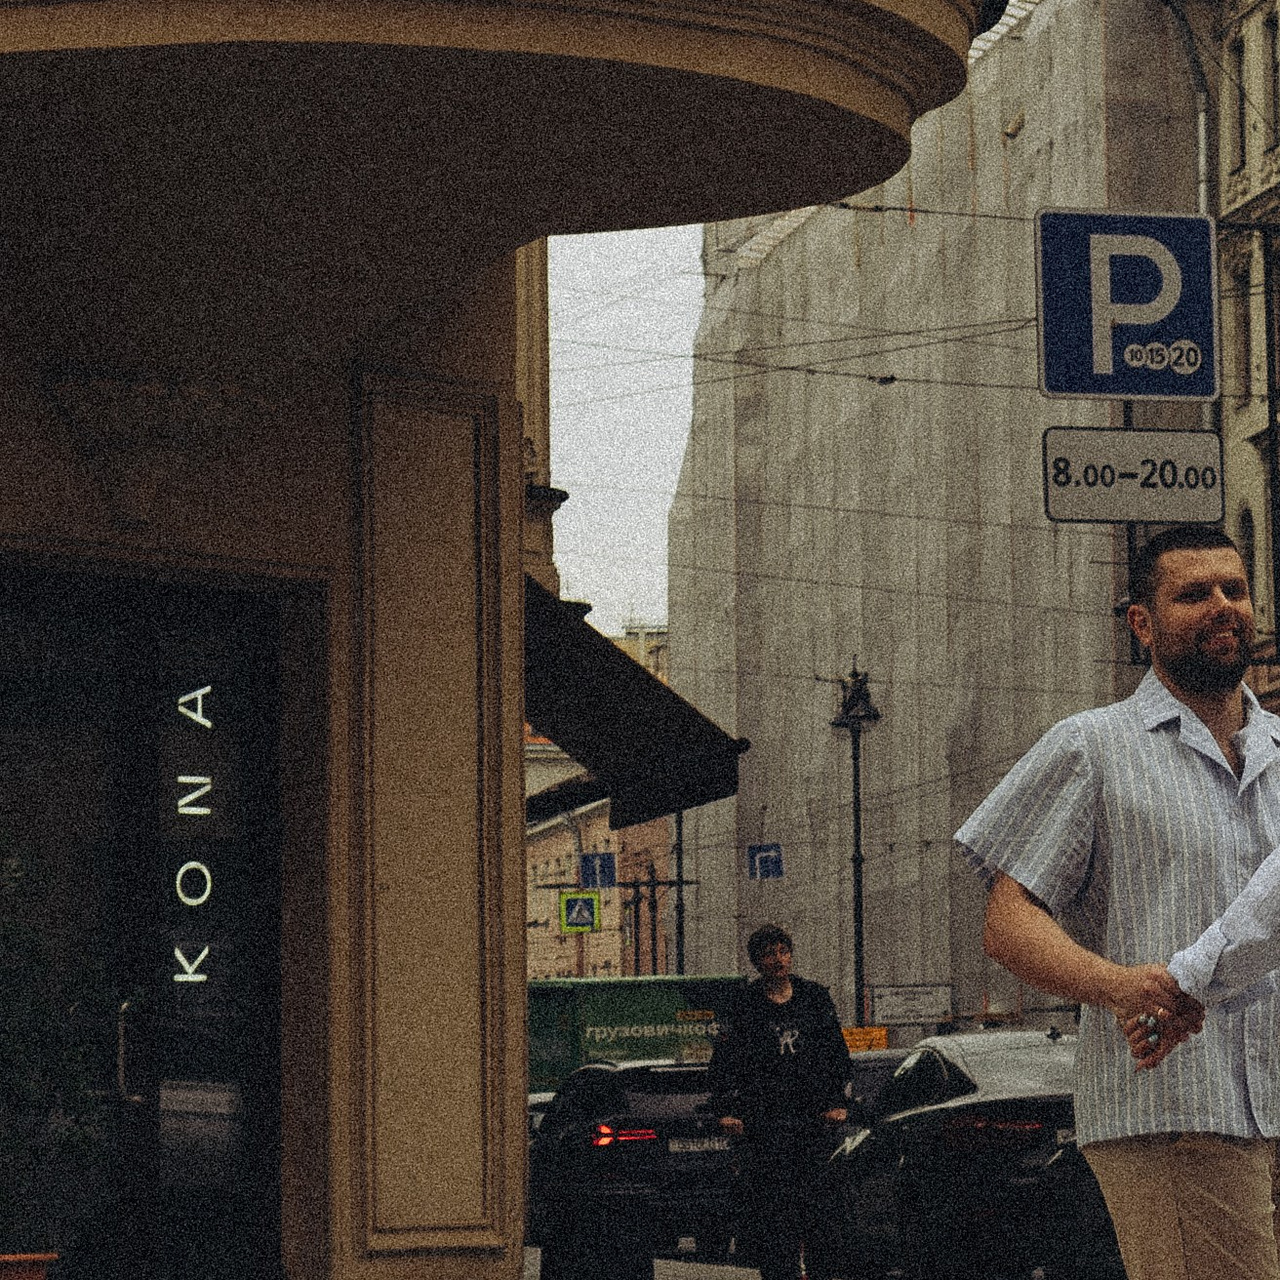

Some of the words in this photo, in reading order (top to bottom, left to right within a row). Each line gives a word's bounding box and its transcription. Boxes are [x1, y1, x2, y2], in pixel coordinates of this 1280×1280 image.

[1089, 234, 1183, 375] P
[1149, 346, 1166, 364] 15
[1172, 346, 1199, 367] 20
[172, 685, 213, 983] KONA
